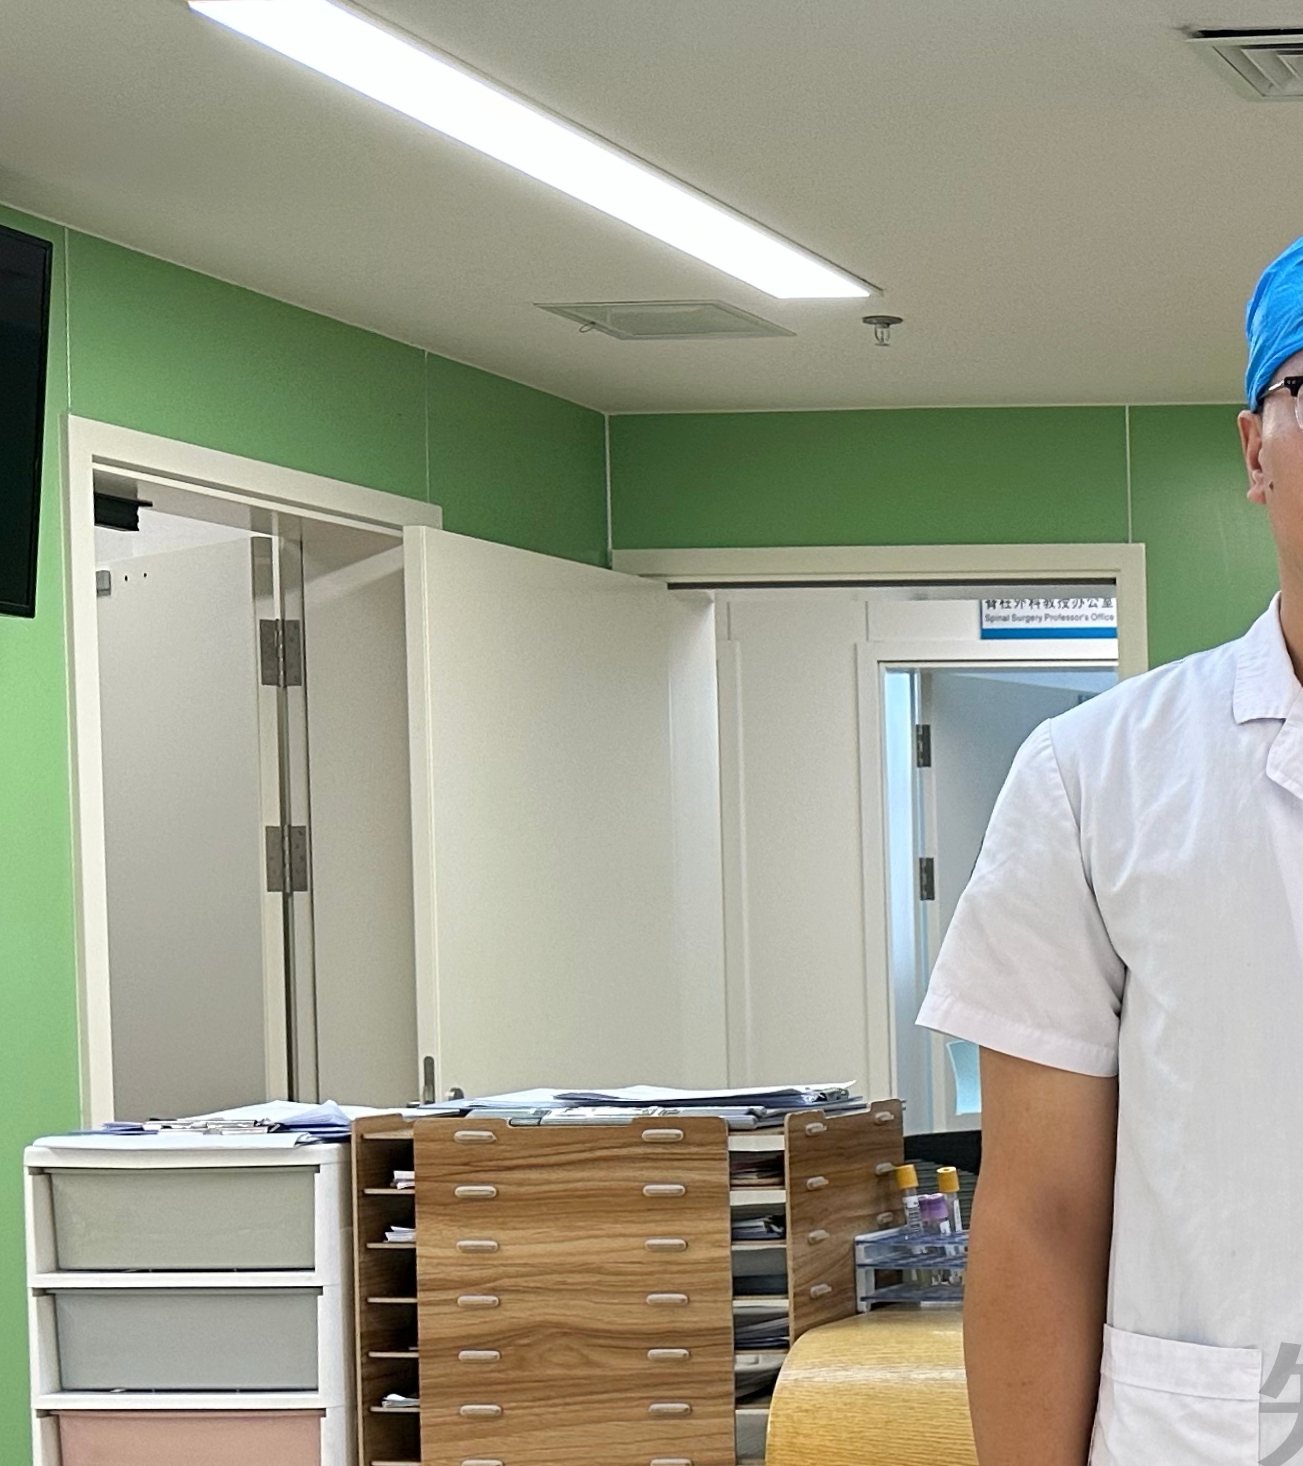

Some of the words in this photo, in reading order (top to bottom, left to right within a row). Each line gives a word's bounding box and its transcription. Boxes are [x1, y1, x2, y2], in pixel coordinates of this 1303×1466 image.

[985, 613, 1010, 623] Spinal
[1012, 613, 1042, 623] Surgery
[1044, 612, 1089, 622] Professor's
[1090, 612, 1115, 621] Office
